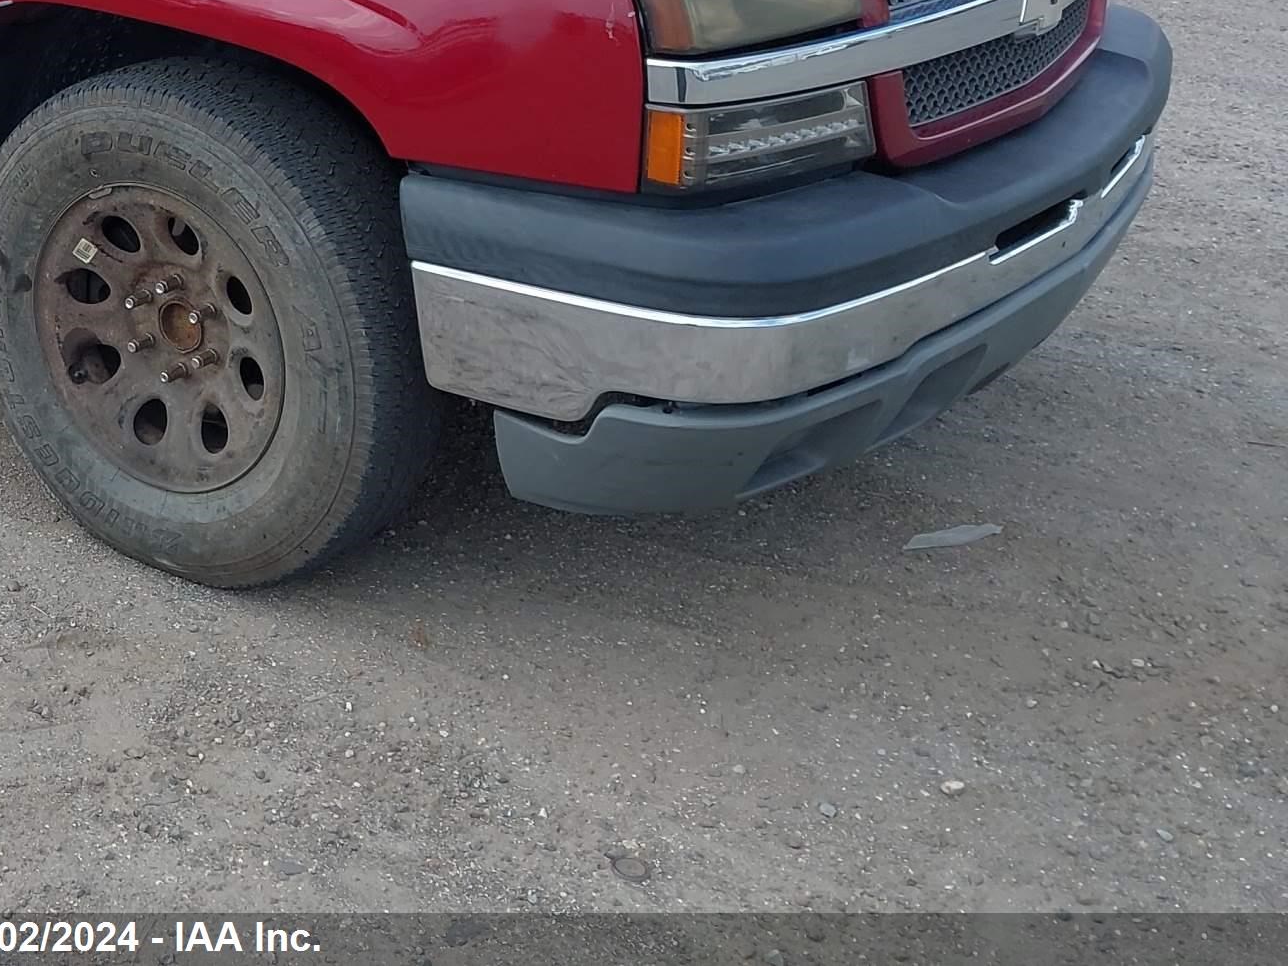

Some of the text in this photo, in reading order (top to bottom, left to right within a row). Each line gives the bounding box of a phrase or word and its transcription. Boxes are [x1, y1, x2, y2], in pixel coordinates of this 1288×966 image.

[79, 130, 291, 268] DUELER
[176, 921, 243, 952] IAA
[256, 921, 320, 952] Inc.
